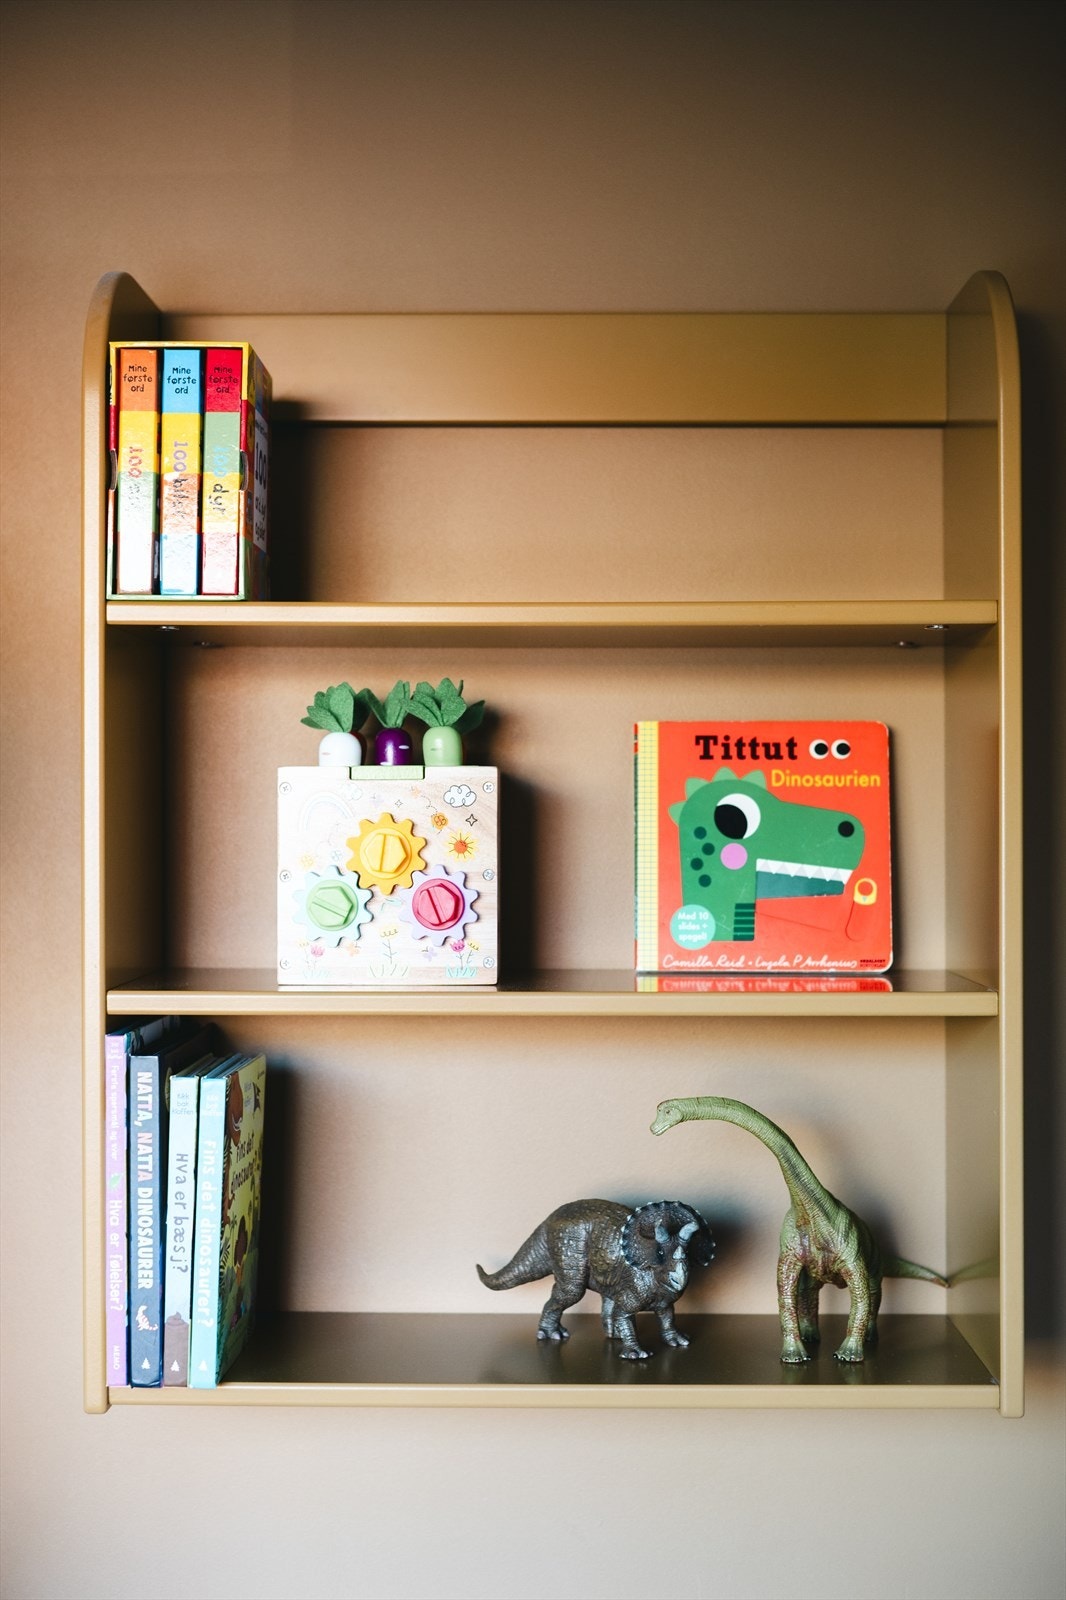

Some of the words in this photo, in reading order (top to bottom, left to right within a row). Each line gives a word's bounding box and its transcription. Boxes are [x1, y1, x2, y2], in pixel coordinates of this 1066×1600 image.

[123, 374, 153, 383] første
[129, 365, 147, 373] Mine
[167, 375, 197, 385] første
[172, 366, 191, 375] Mine
[213, 366, 233, 374] Mine
[130, 384, 145, 392] ord
[174, 386, 189, 394] ord
[215, 385, 230, 394] ord
[128, 446, 143, 479] 100
[173, 440, 189, 473] 100
[213, 446, 229, 478] 100
[695, 735, 798, 760] Tittut
[770, 769, 881, 787] Dinosaurien
[678, 911, 697, 920] Med
[699, 911, 709, 920] 10
[678, 921, 701, 930] slides
[662, 954, 714, 968] Camilla
[715, 954, 746, 968] Reid
[792, 954, 803, 968] P
[134, 1072, 153, 1127] NATTA,
[137, 1132, 153, 1182] NATTA
[202, 1140, 217, 1175] Fins
[175, 1153, 189, 1184] Hva
[174, 1191, 187, 1210] er
[201, 1181, 217, 1212] det
[110, 1199, 123, 1227] Hva
[109, 1232, 120, 1248] er
[137, 1187, 154, 1289] DINOSAURER
[170, 1216, 189, 1273] bæsj?
[109, 1254, 123, 1311] følelser?
[196, 1218, 215, 1328] dinosaurer?
